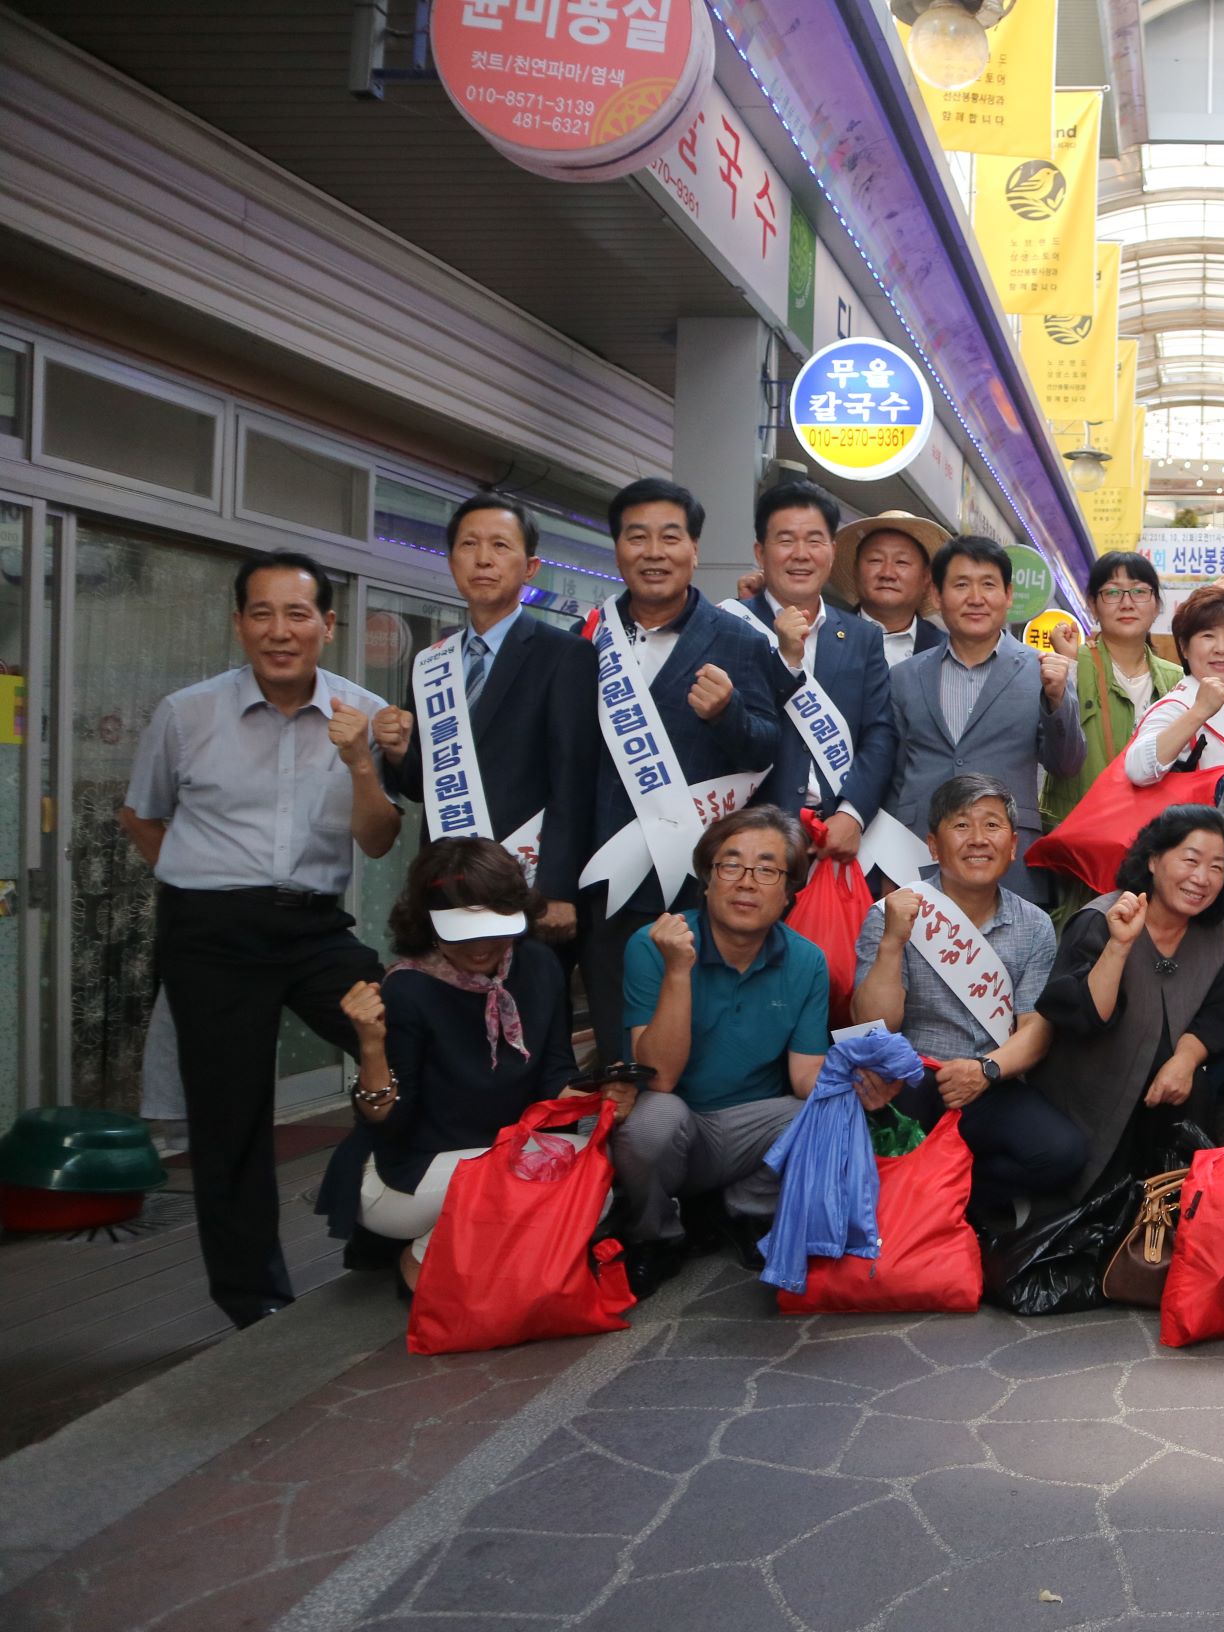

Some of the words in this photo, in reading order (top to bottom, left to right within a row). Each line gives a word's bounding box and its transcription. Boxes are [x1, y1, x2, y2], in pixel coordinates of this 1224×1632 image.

[471, 50, 625, 87] 컷트/천연파마/염색
[466, 85, 595, 117] 010-8571-3139
[512, 111, 591, 136] 481-6321
[809, 391, 910, 422] 칼국수
[809, 428, 905, 447] 010-2970-9361
[423, 661, 478, 839] 구미을당원협
[968, 971, 1016, 1036] 한가
